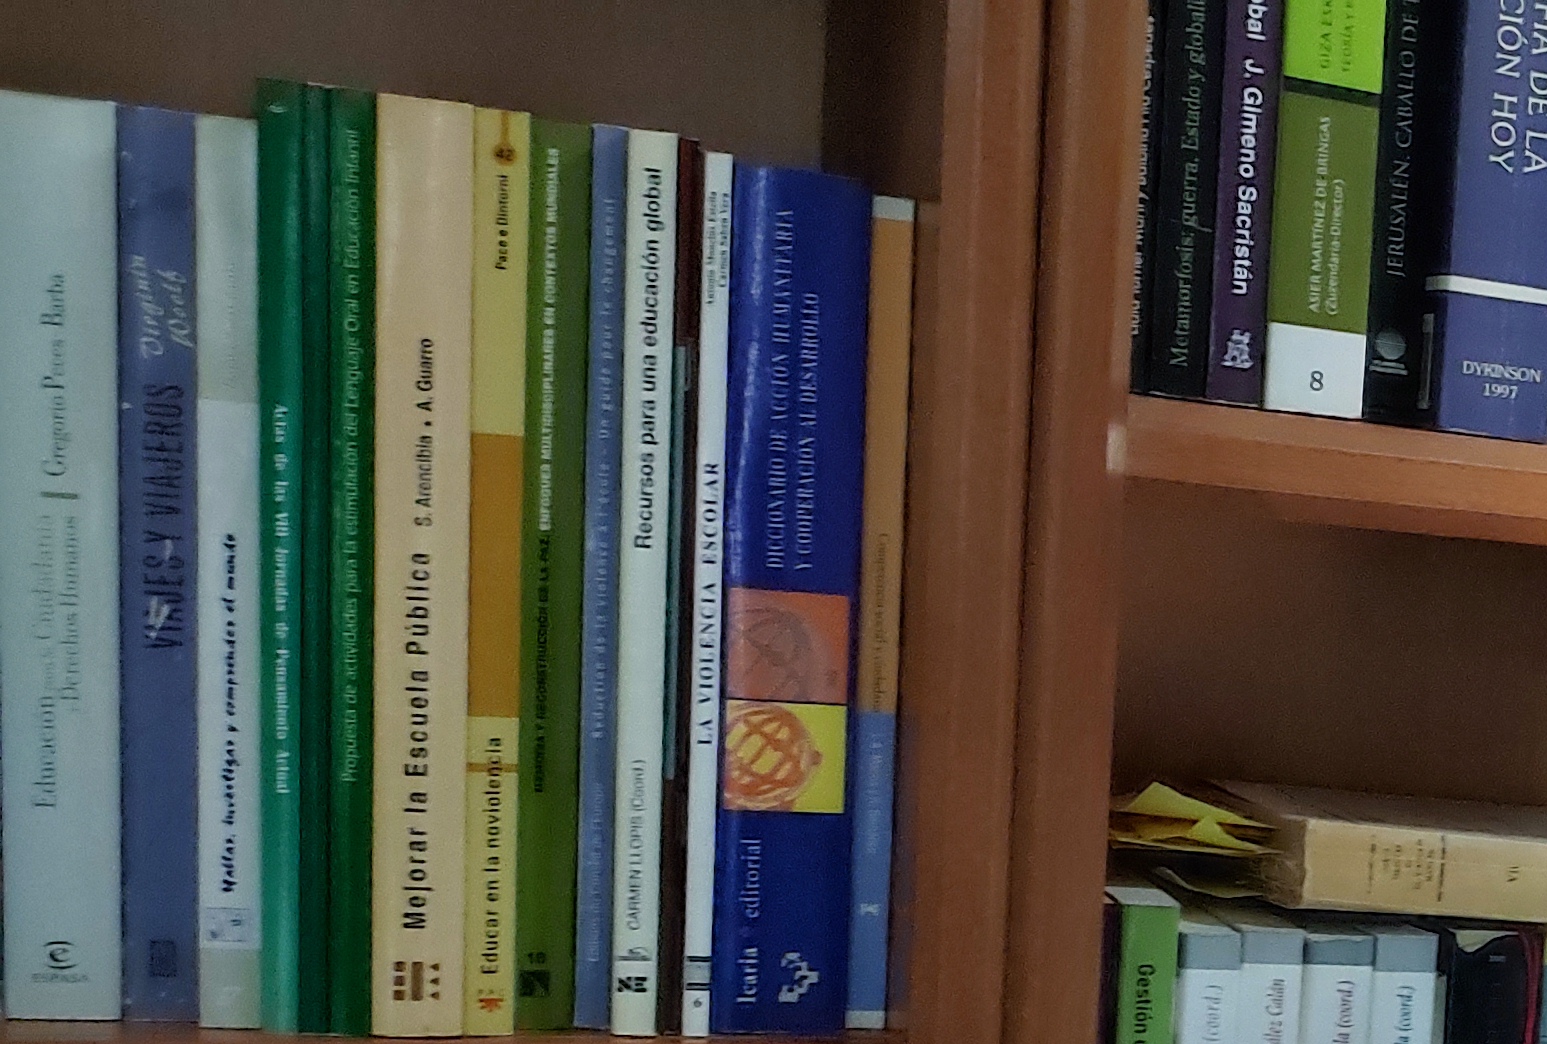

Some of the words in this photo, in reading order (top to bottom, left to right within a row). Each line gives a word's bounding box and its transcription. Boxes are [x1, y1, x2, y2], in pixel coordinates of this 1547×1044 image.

[1242, 58, 1265, 80] J.
[1179, 85, 1201, 149] Estado
[1236, 86, 1265, 180] Gimeno
[1487, 93, 1518, 173] HOY
[343, 128, 360, 183] Infantil
[343, 188, 360, 268] Educación
[641, 167, 668, 231] global
[1230, 185, 1263, 297] Sacristán
[346, 273, 360, 292] en
[637, 239, 662, 346] educación
[770, 208, 795, 343] HUMANITARIA
[1165, 230, 1197, 366] Metamorfosis:
[342, 298, 359, 330] Oral
[797, 292, 820, 402] DESARROLLO
[342, 336, 362, 407] Lenguaje
[415, 337, 435, 391] Guarro
[641, 354, 658, 391] una
[765, 353, 790, 420] ACCIÓN
[1309, 370, 1325, 392] 8
[1482, 382, 1519, 401] 1997
[40, 395, 71, 476] Gregorio
[342, 410, 359, 431] del
[416, 396, 434, 411] A.
[641, 399, 662, 445] para
[798, 409, 816, 426] AL
[141, 382, 185, 516] VIAJEROS
[415, 434, 435, 505] Arencibia
[768, 428, 787, 451] DE
[342, 436, 359, 535] estimulación
[415, 512, 434, 526] S.
[633, 453, 656, 548] Recursos
[699, 461, 720, 564] ESCOLAR
[765, 457, 787, 568] DICCIONARIO
[793, 436, 816, 554] COOPERACIÓN
[58, 515, 81, 606] Humanos
[142, 529, 183, 543] Y
[342, 539, 358, 553] la
[141, 554, 185, 648] VIAJES
[346, 558, 361, 591] para
[403, 552, 432, 655] Pública
[58, 612, 81, 700] Derechos
[342, 598, 359, 679] actividades
[697, 581, 718, 703] VIOLENCIA
[342, 683, 357, 697] de
[405, 669, 430, 776] Escuela
[30, 696, 56, 807] Educación
[341, 701, 360, 781] Propuesta
[696, 718, 715, 745] LA
[403, 790, 428, 812] la
[481, 736, 504, 849] noviolencia
[628, 758, 647, 811] (Coord.)
[481, 854, 501, 873] la
[627, 815, 645, 864] LLOPIS
[402, 826, 435, 929] Mejorar
[487, 879, 501, 901] en
[626, 868, 644, 930] CARMEN
[738, 838, 762, 917] editorial
[481, 909, 502, 974] Educar
[736, 947, 759, 1003] Icaria
[1132, 963, 1156, 1034] Gestión
[1395, 984, 1417, 1031] (coord.)
